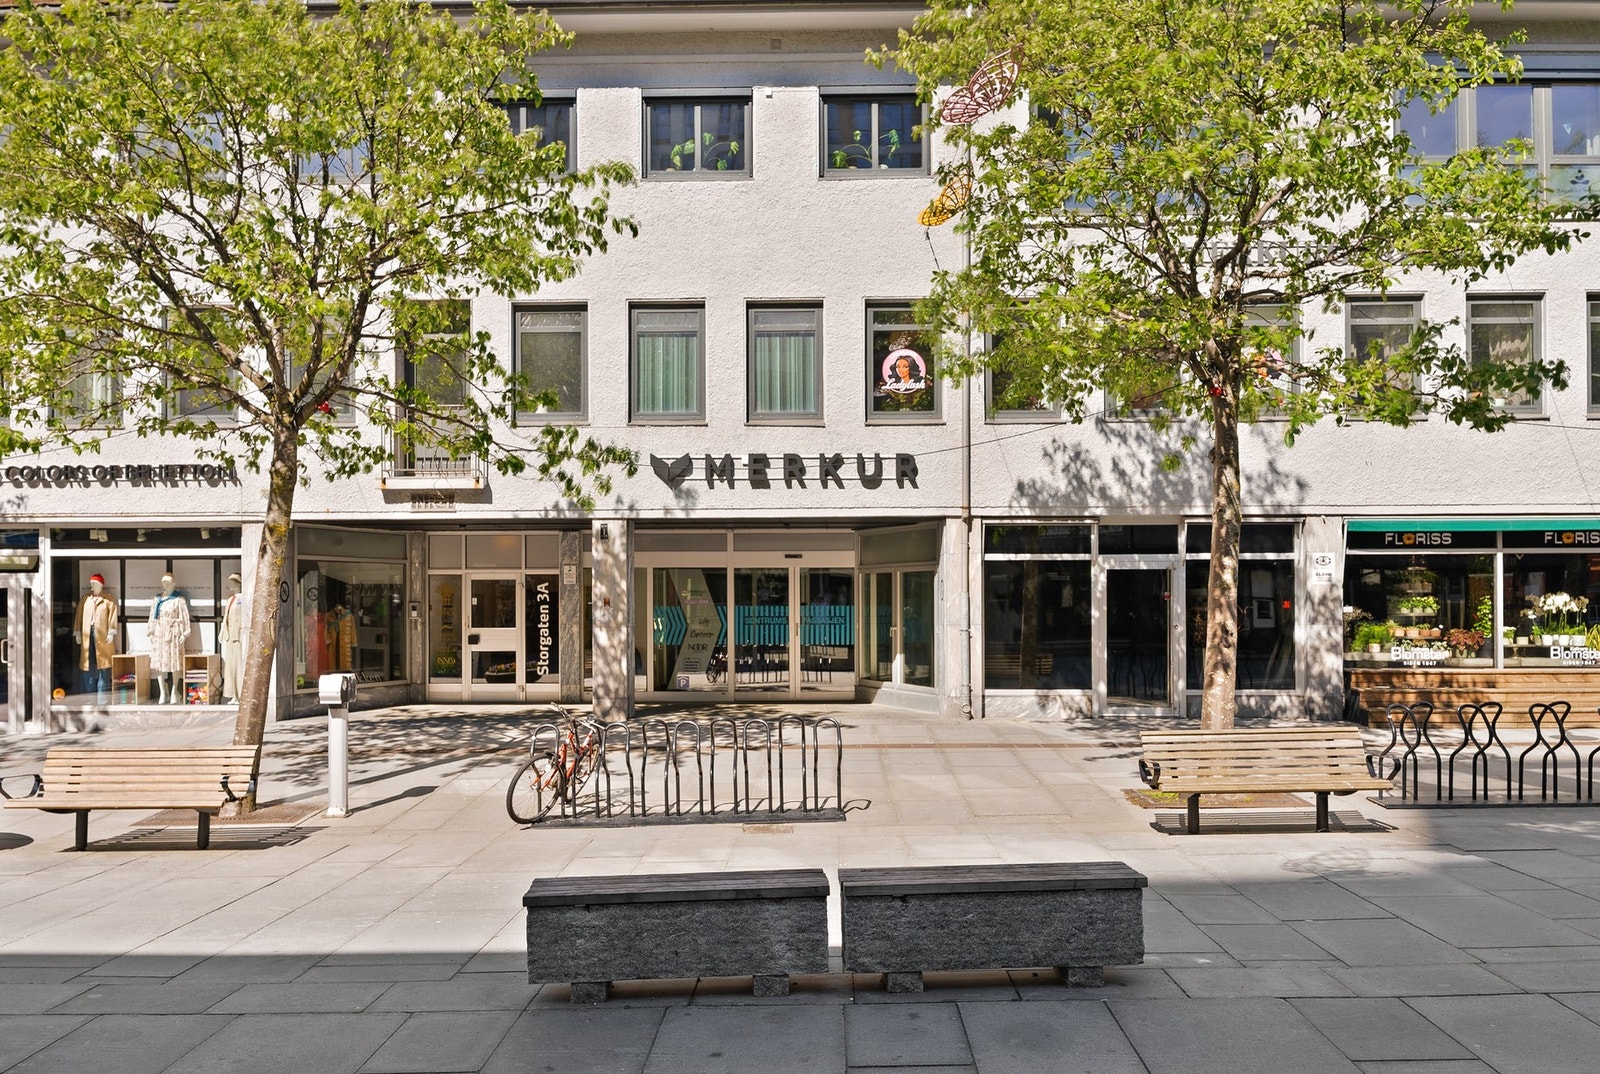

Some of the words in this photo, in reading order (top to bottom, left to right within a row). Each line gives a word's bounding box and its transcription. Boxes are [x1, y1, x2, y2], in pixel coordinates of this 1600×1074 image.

[5, 465, 90, 481] COLORS
[92, 465, 120, 481] OF
[125, 464, 235, 480] BENETTON
[705, 453, 916, 482] MERKUR
[1385, 532, 1452, 545] FLORISS
[536, 582, 550, 602] 3A
[744, 616, 787, 624] SENTRUMS
[801, 616, 845, 624] PASSASJEN
[537, 605, 552, 676] Storgaten
[1390, 646, 1449, 660] Blomster
[680, 679, 687, 687] P
